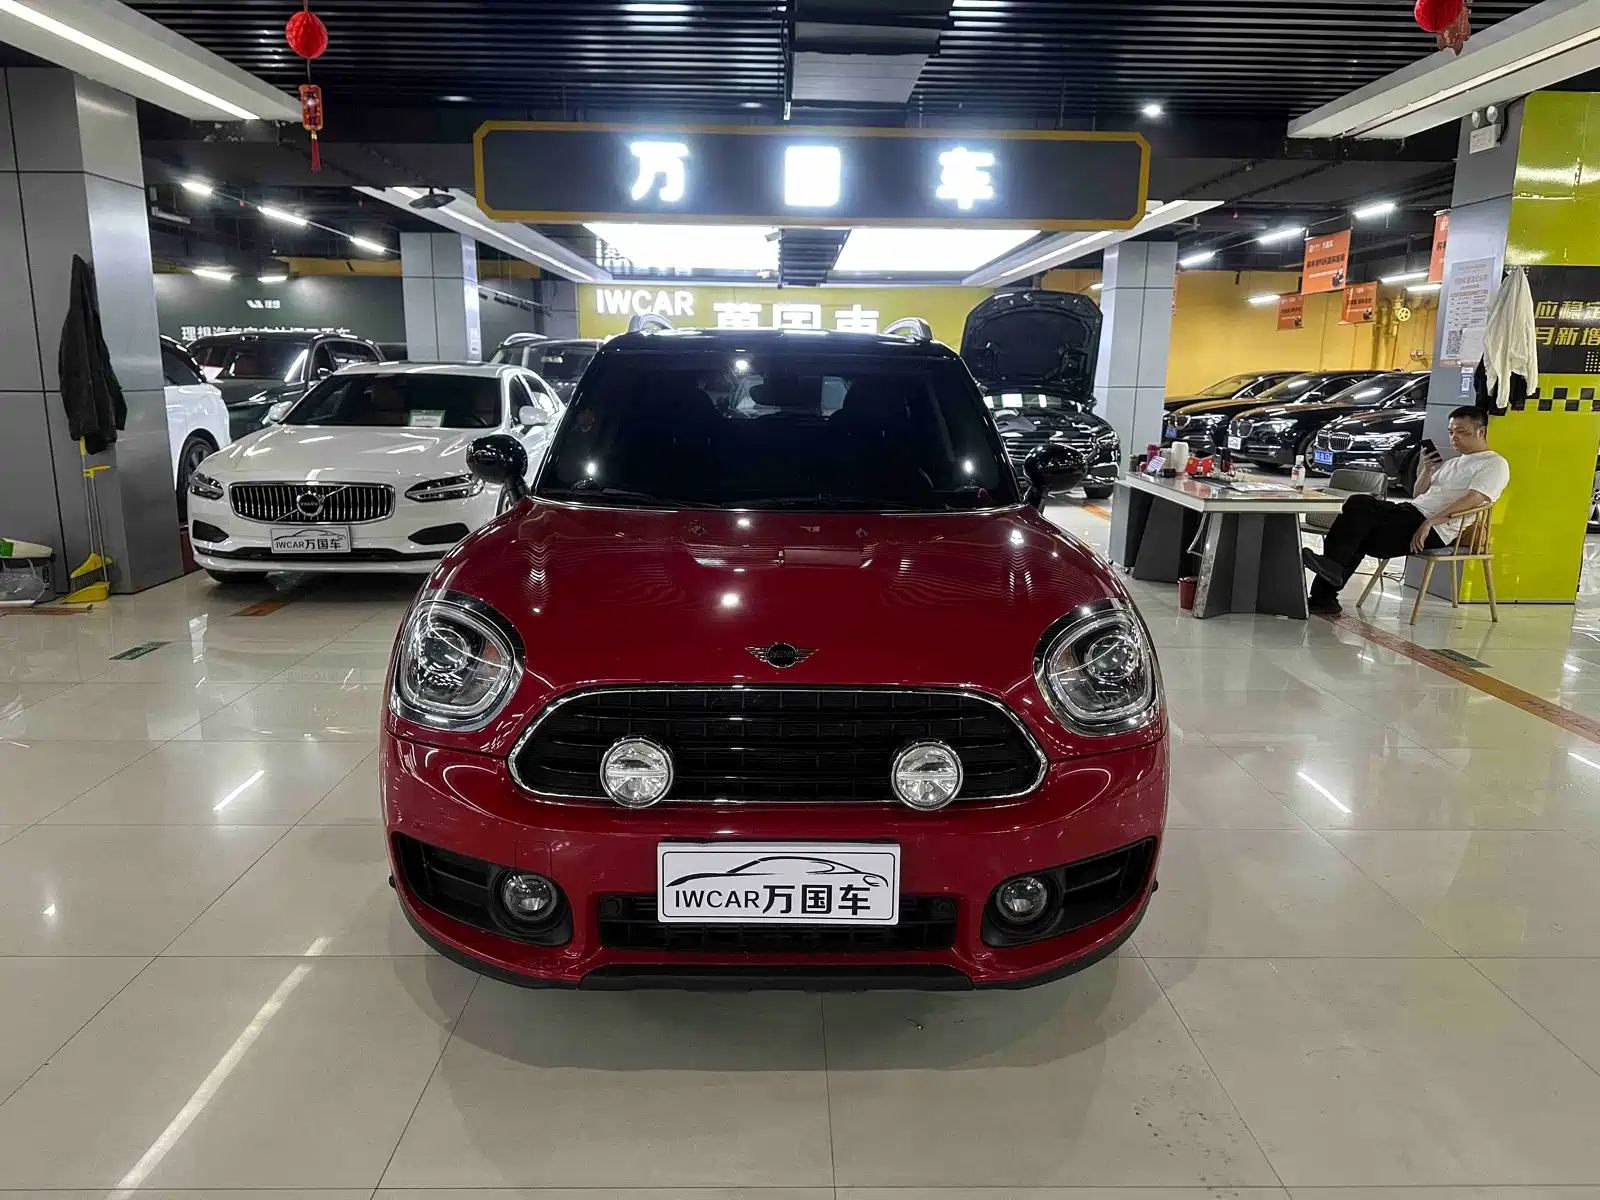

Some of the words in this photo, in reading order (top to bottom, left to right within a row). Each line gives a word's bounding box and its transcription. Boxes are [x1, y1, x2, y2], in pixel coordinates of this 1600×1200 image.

[630, 141, 995, 210] 万车
[596, 288, 695, 316] IWCAR
[675, 884, 871, 915] IWCAR万国车
